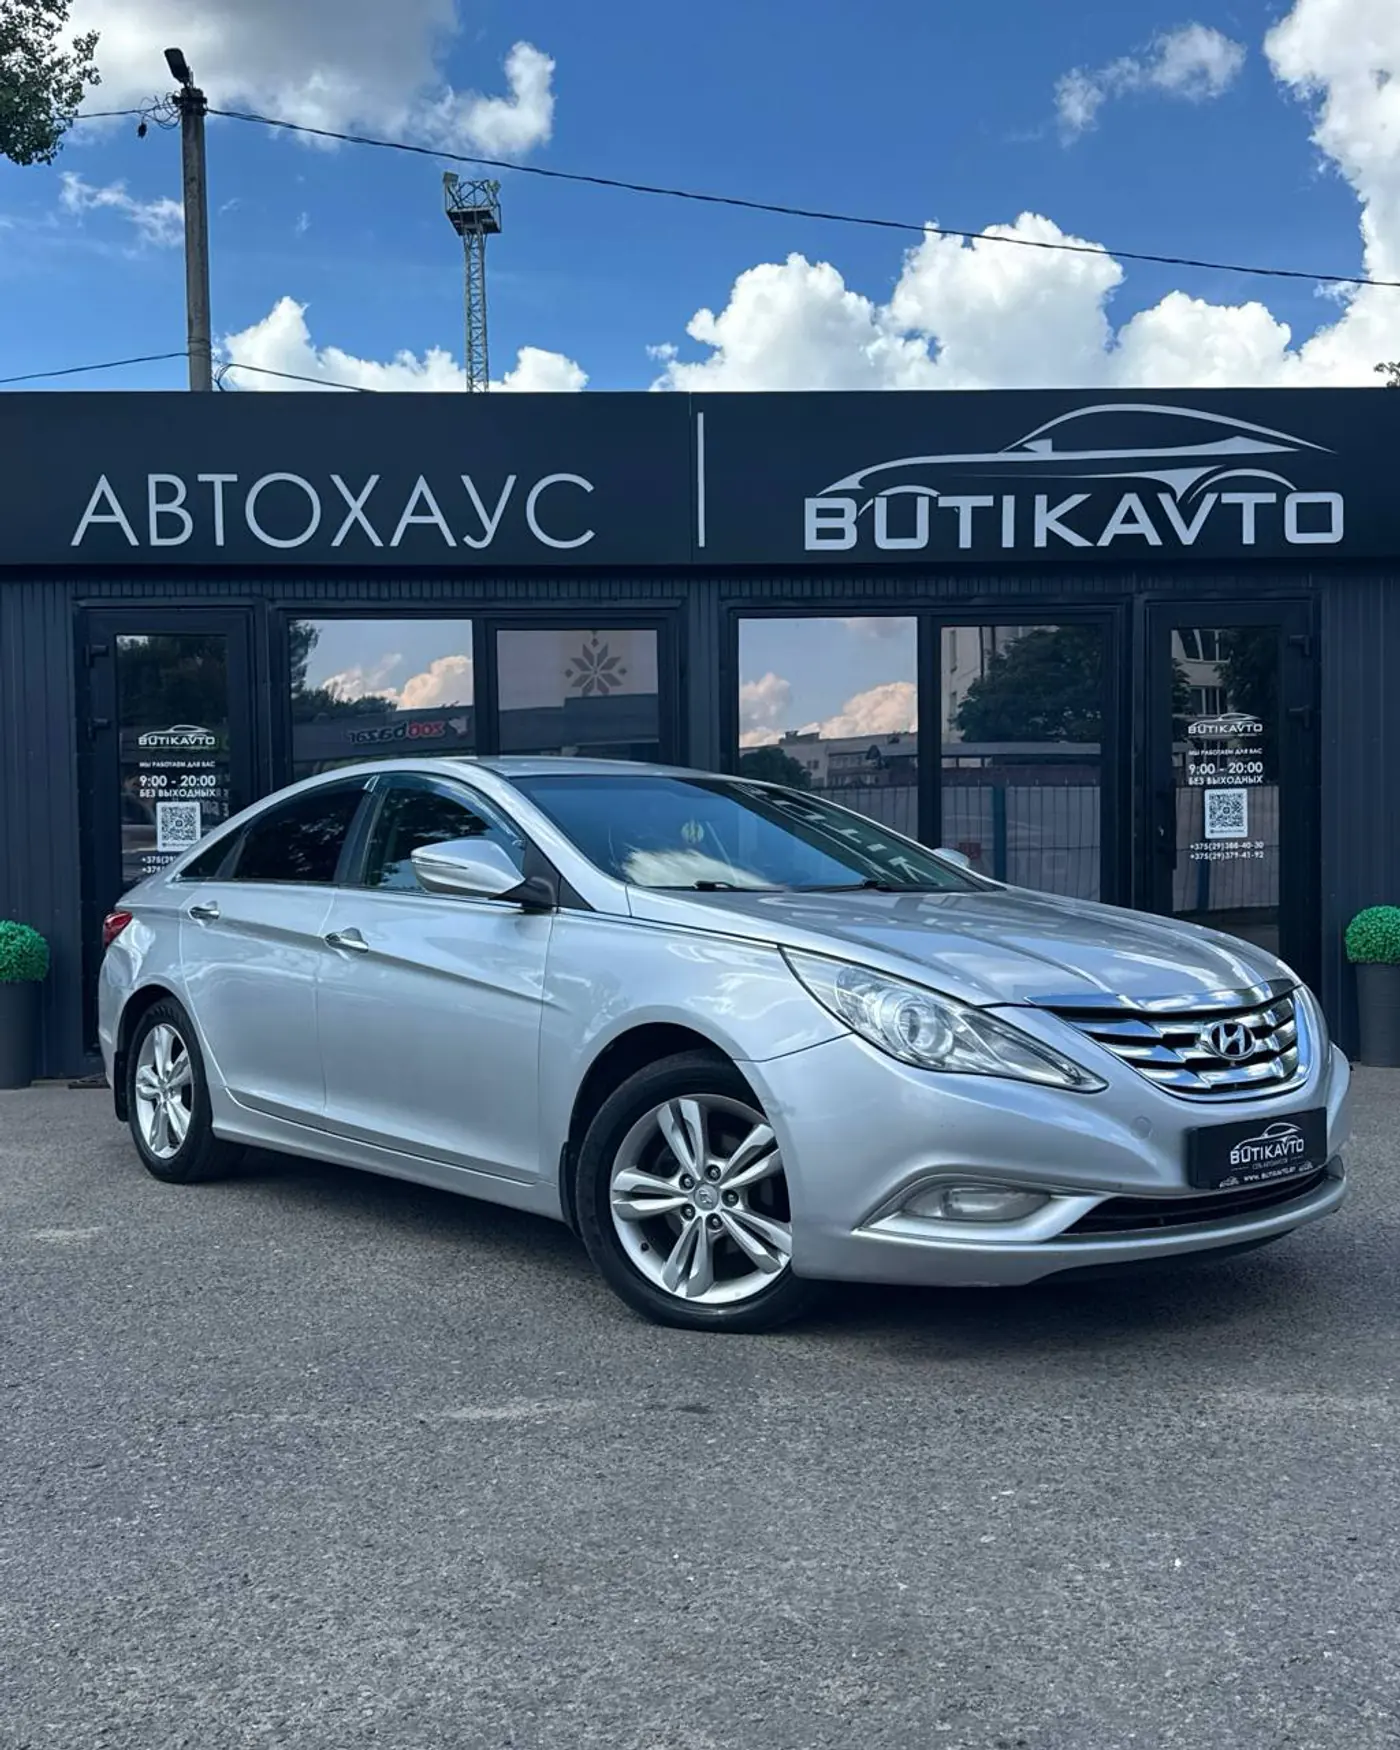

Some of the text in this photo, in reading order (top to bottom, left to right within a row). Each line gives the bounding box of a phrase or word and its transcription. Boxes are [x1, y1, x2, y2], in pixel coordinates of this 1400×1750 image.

[71, 472, 596, 549] АВТОХАУС
[804, 491, 1344, 551] BUTIKAVTO
[1188, 724, 1263, 734] BUTIKAVTO
[138, 736, 215, 746] BUTIKAVTO
[1188, 763, 1216, 775] 9:00
[1228, 762, 1263, 774] 20:00
[139, 775, 167, 787] 9:00
[180, 775, 216, 787] 20:00
[1188, 775, 1263, 785] БЕЗ ВЫХОДНЫХ
[139, 788, 216, 798] БЕЗ ВЫХОДНЫХ
[1230, 1138, 1304, 1165] BUTIKAVTO
